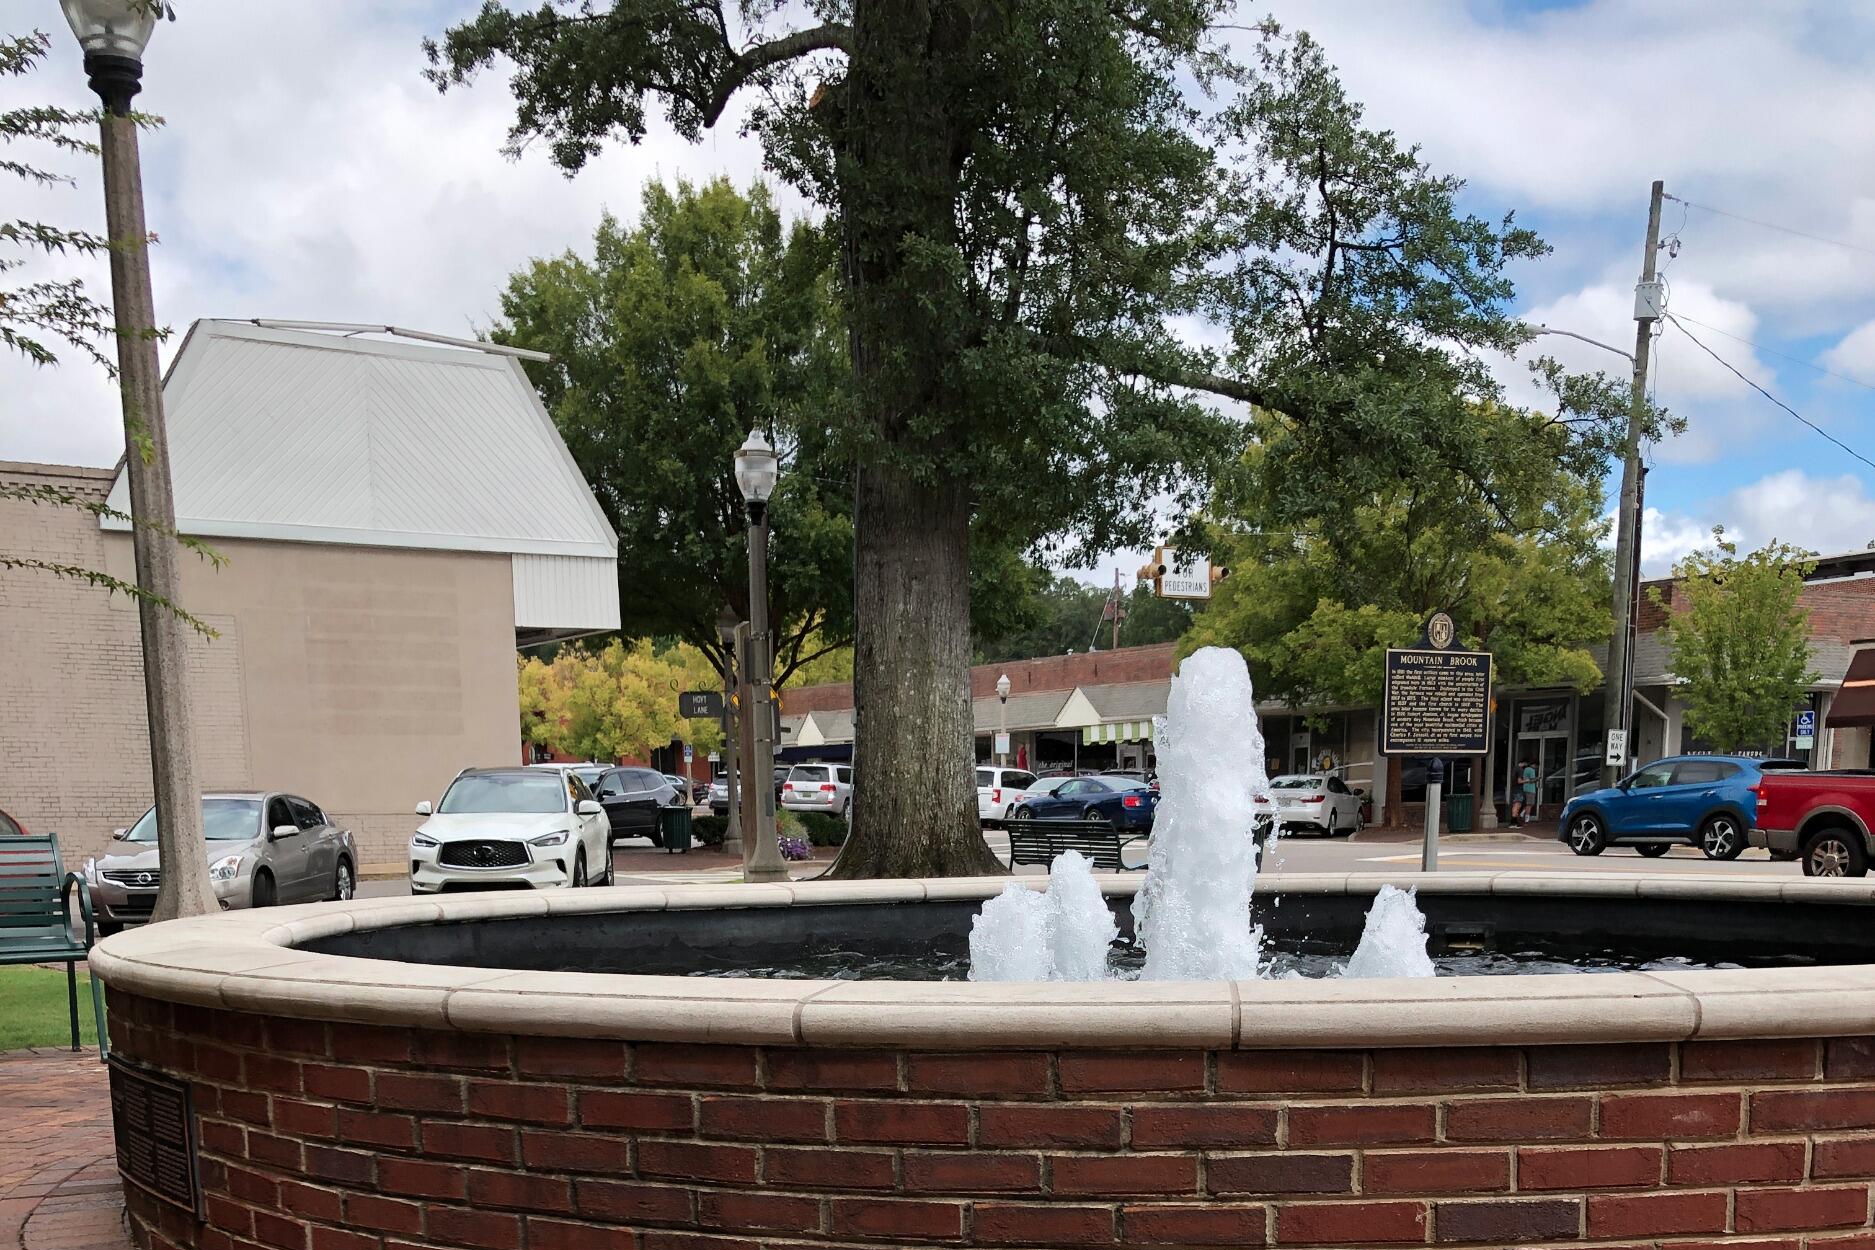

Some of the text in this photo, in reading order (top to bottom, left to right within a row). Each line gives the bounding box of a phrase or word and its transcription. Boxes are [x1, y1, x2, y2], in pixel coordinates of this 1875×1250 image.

[1164, 580, 1207, 593] PEDESTRIANS
[1400, 655, 1478, 667] MOUNTAIN BROOK
[693, 705, 709, 714] LANE
[1611, 733, 1624, 742] ONE
[1611, 743, 1623, 751] WAY
